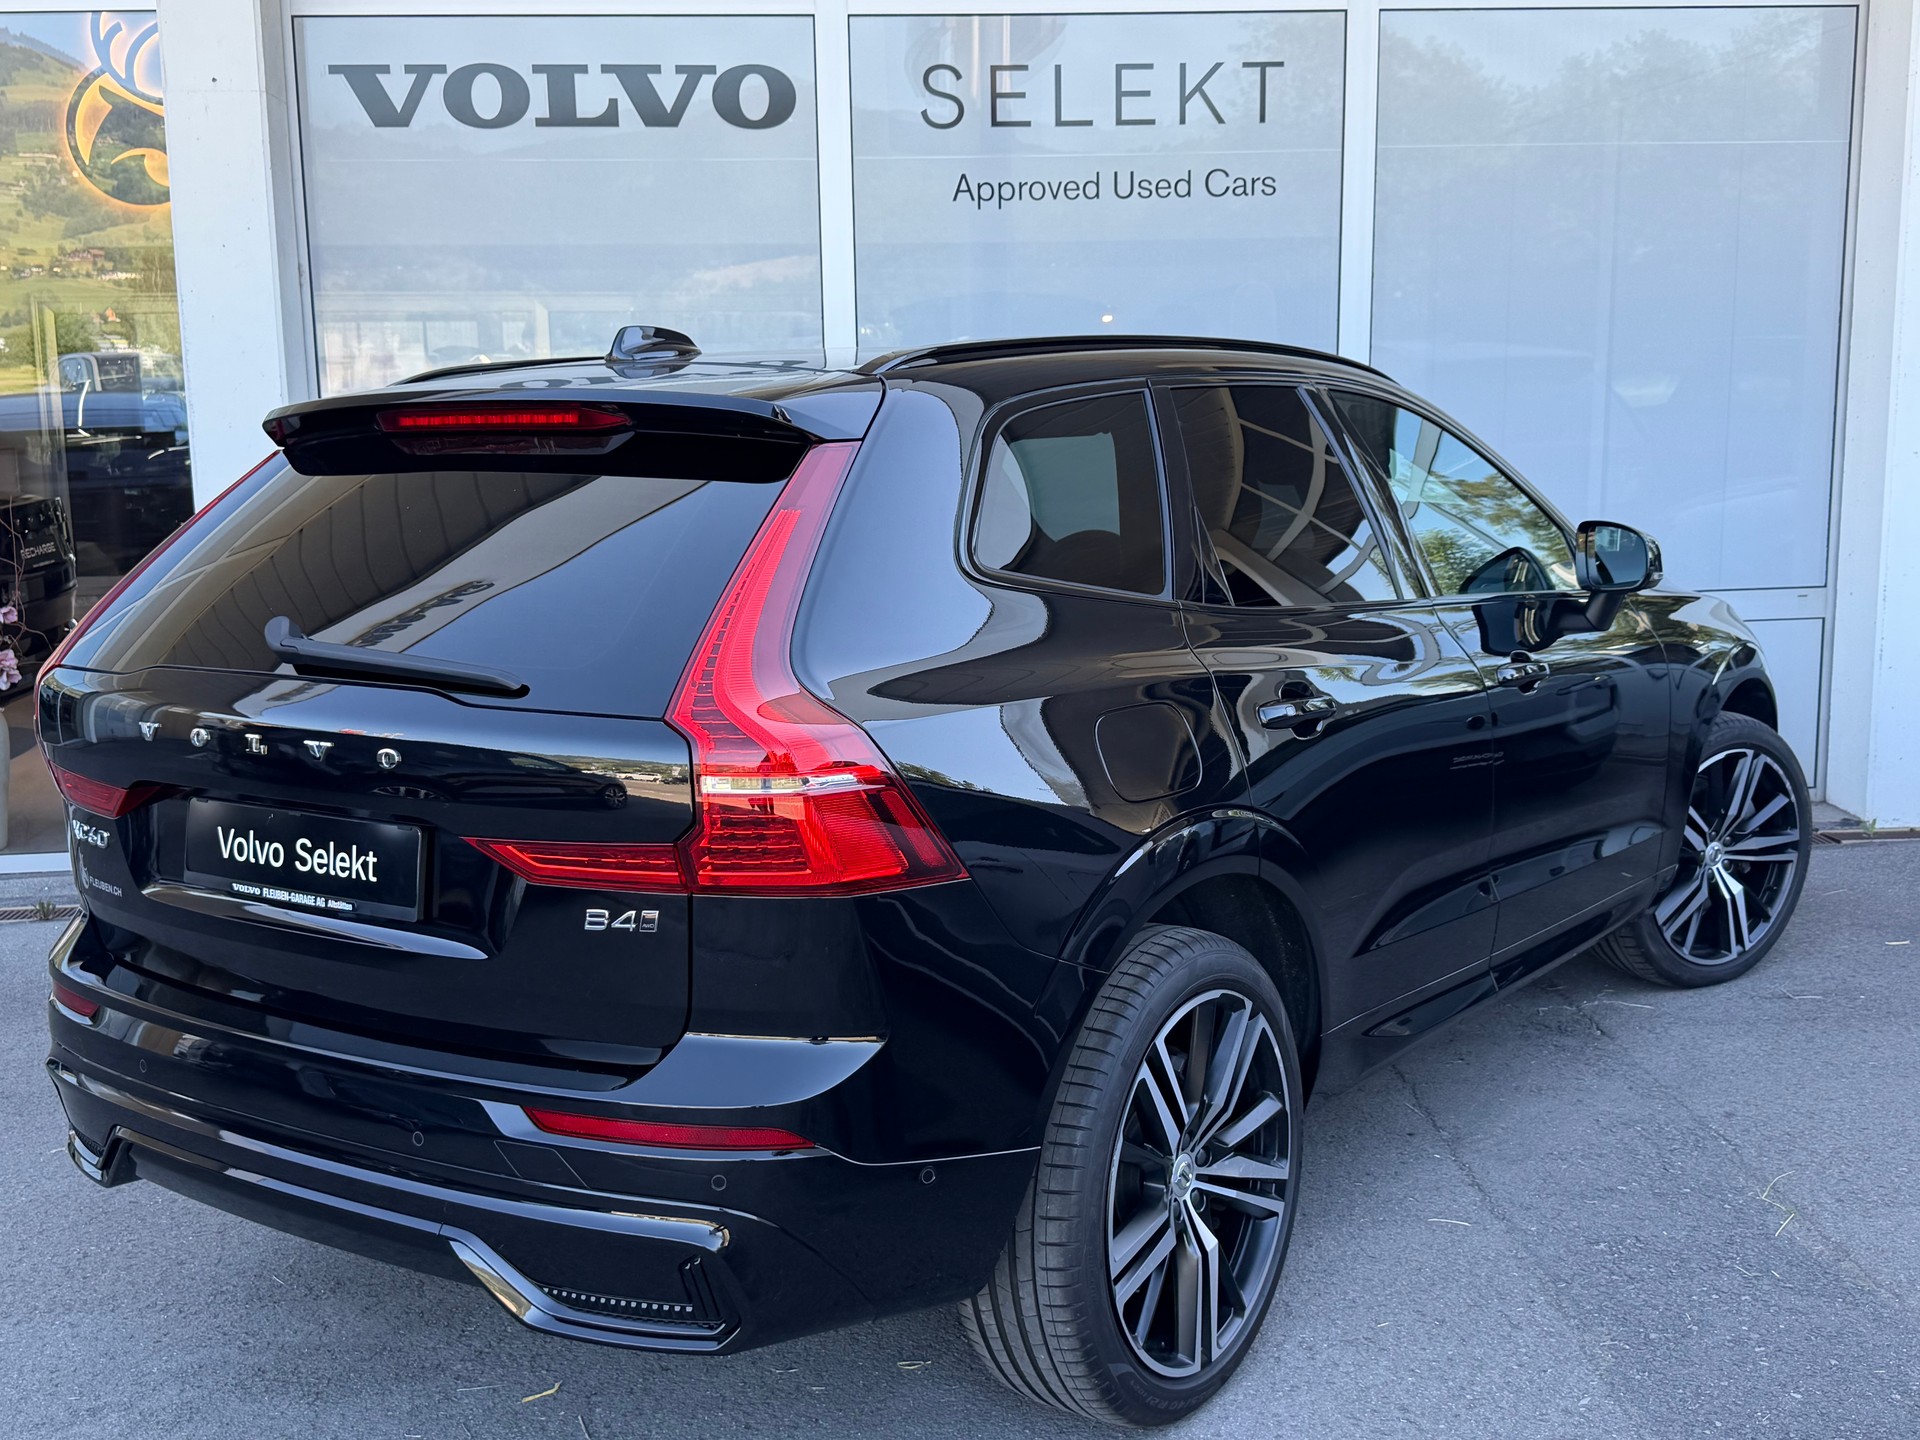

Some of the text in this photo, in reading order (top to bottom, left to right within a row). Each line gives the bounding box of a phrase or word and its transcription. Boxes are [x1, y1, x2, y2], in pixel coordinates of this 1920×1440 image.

[327, 62, 797, 130] VOLVO
[921, 61, 1285, 130] SELEKT
[953, 168, 1277, 210] Approved Used Cars
[20, 541, 56, 559] RECHARGE
[138, 721, 401, 770] VOLVO
[217, 825, 378, 882] Volvo Selekt
[232, 882, 261, 896] VOLVO
[262, 887, 316, 906] FLEUBEN-GARAGE
[316, 896, 326, 908] AG
[584, 909, 638, 932] B4
